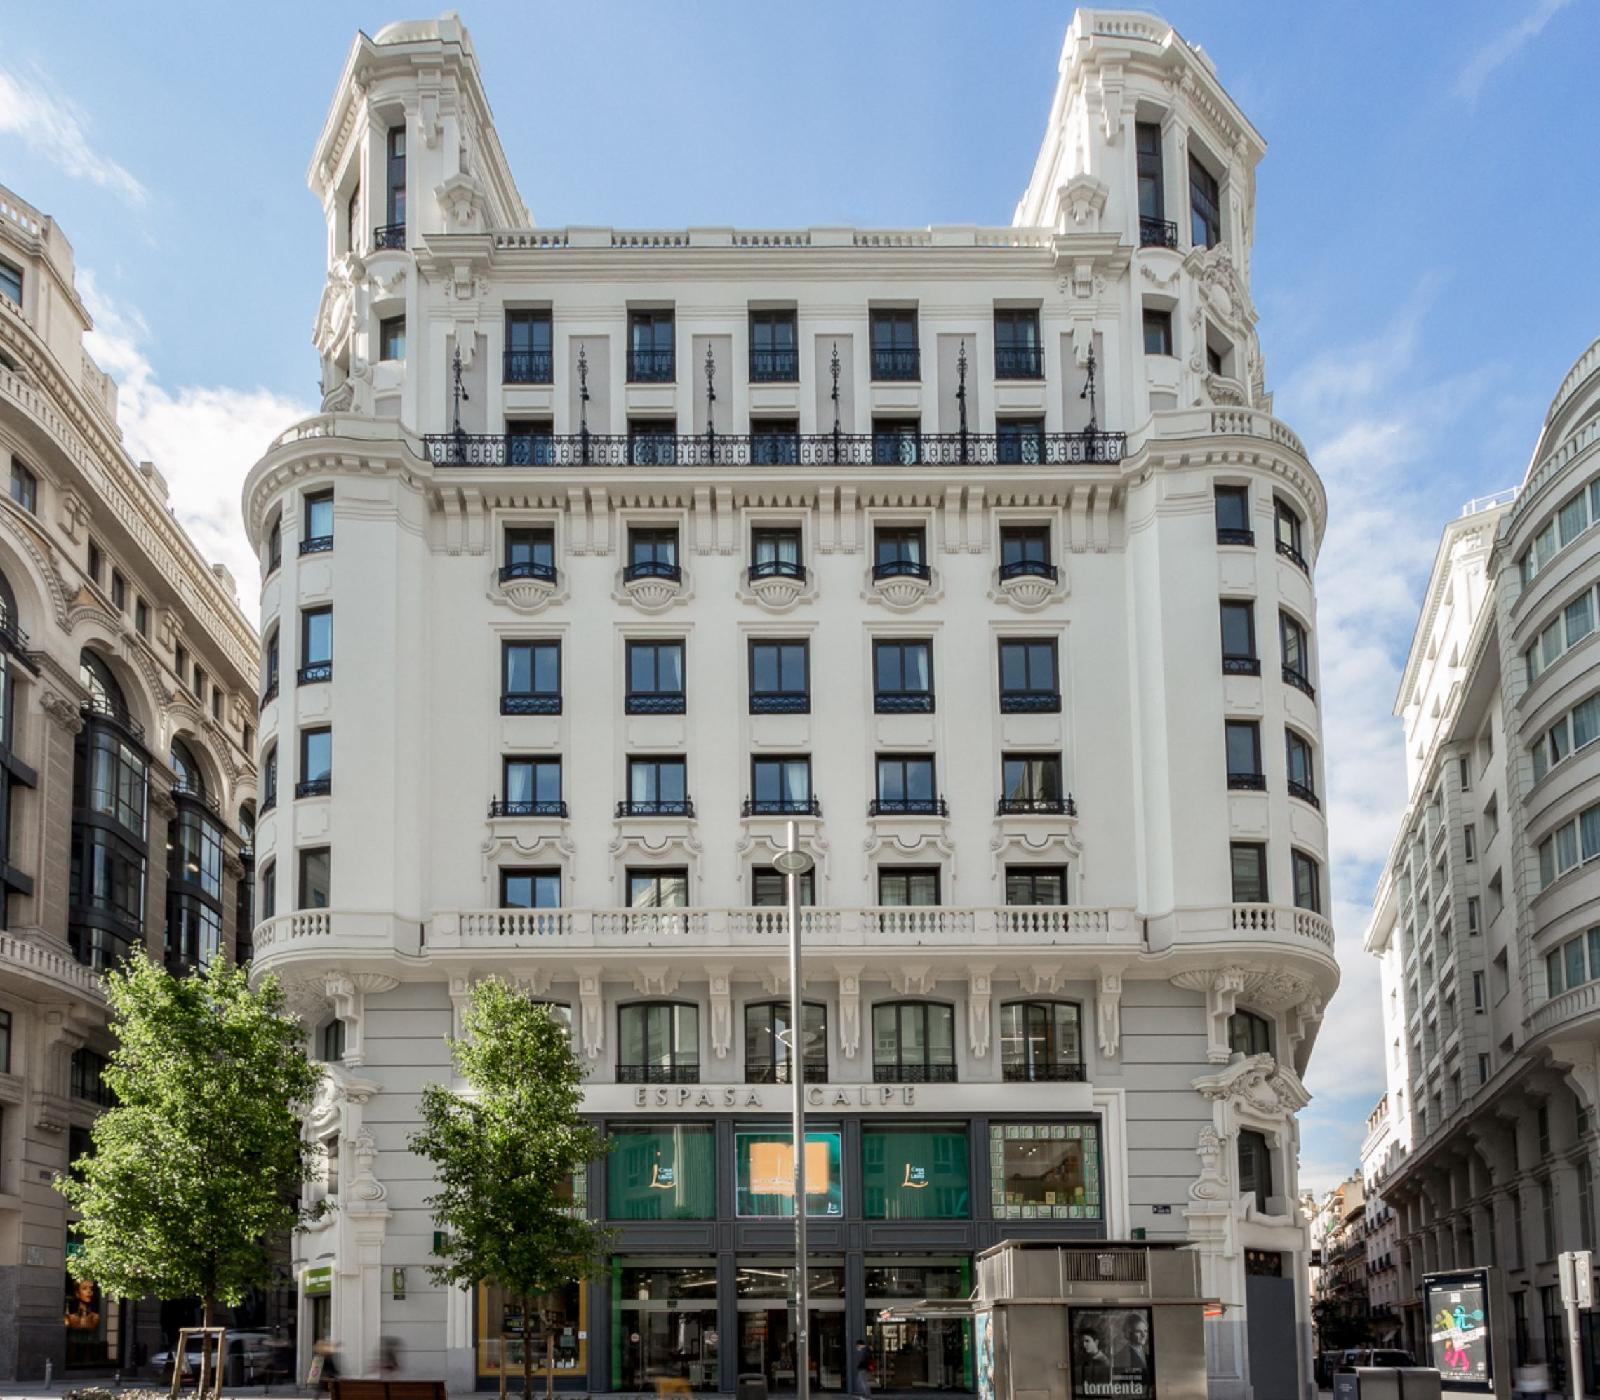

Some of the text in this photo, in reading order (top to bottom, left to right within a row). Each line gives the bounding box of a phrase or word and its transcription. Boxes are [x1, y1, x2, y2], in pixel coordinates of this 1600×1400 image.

[635, 1085, 915, 1107] ESPASA CALPE
[1083, 1380, 1143, 1395] tormenta
